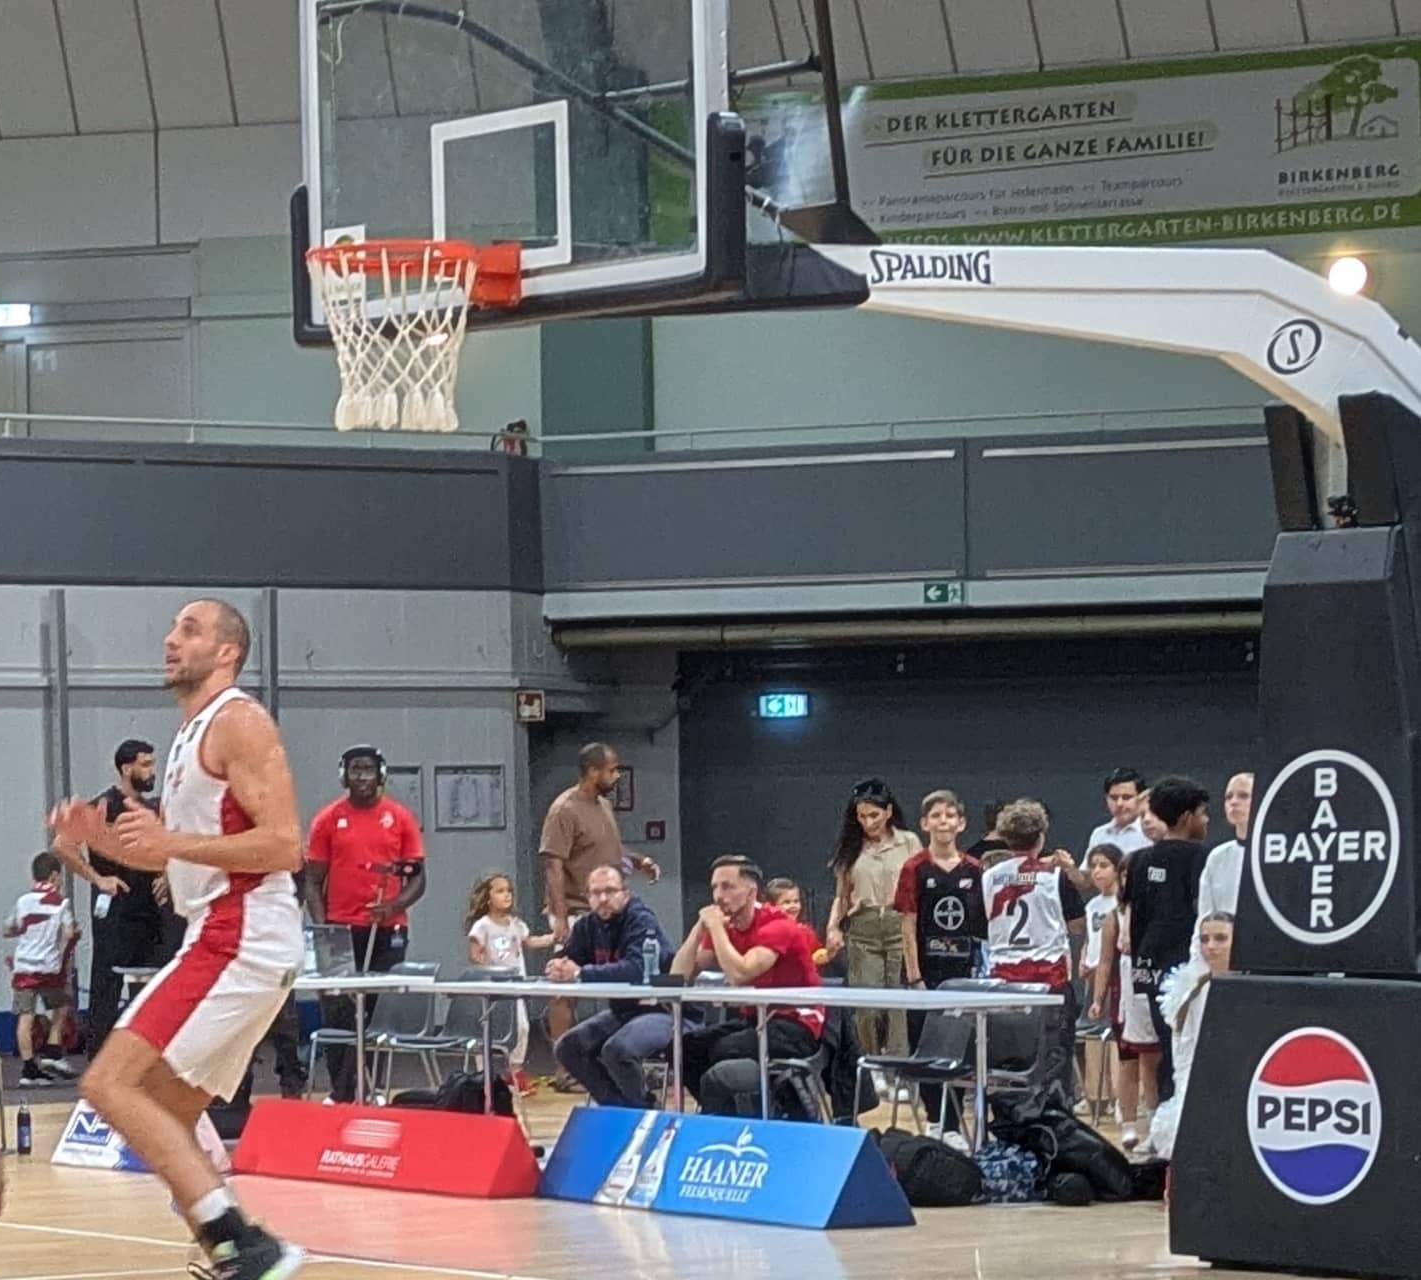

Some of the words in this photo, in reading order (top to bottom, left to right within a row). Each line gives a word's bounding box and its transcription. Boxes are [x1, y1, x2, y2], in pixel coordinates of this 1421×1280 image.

[887, 115, 927, 133] DER
[936, 101, 1115, 129] KLETTERGARTEN
[932, 146, 972, 166] FÜR
[980, 145, 1016, 163] DIE
[1023, 139, 1098, 159] GANZE
[1106, 131, 1204, 153] FAMILIE!
[1278, 163, 1400, 185] BIRKENBERG
[869, 250, 992, 284] SPALDING
[1264, 830, 1386, 863] BAYER
[1310, 767, 1338, 928] BAYER
[1006, 898, 1031, 946] 2
[1257, 1095, 1371, 1135] PEPSI
[679, 1156, 769, 1189] HAANER
